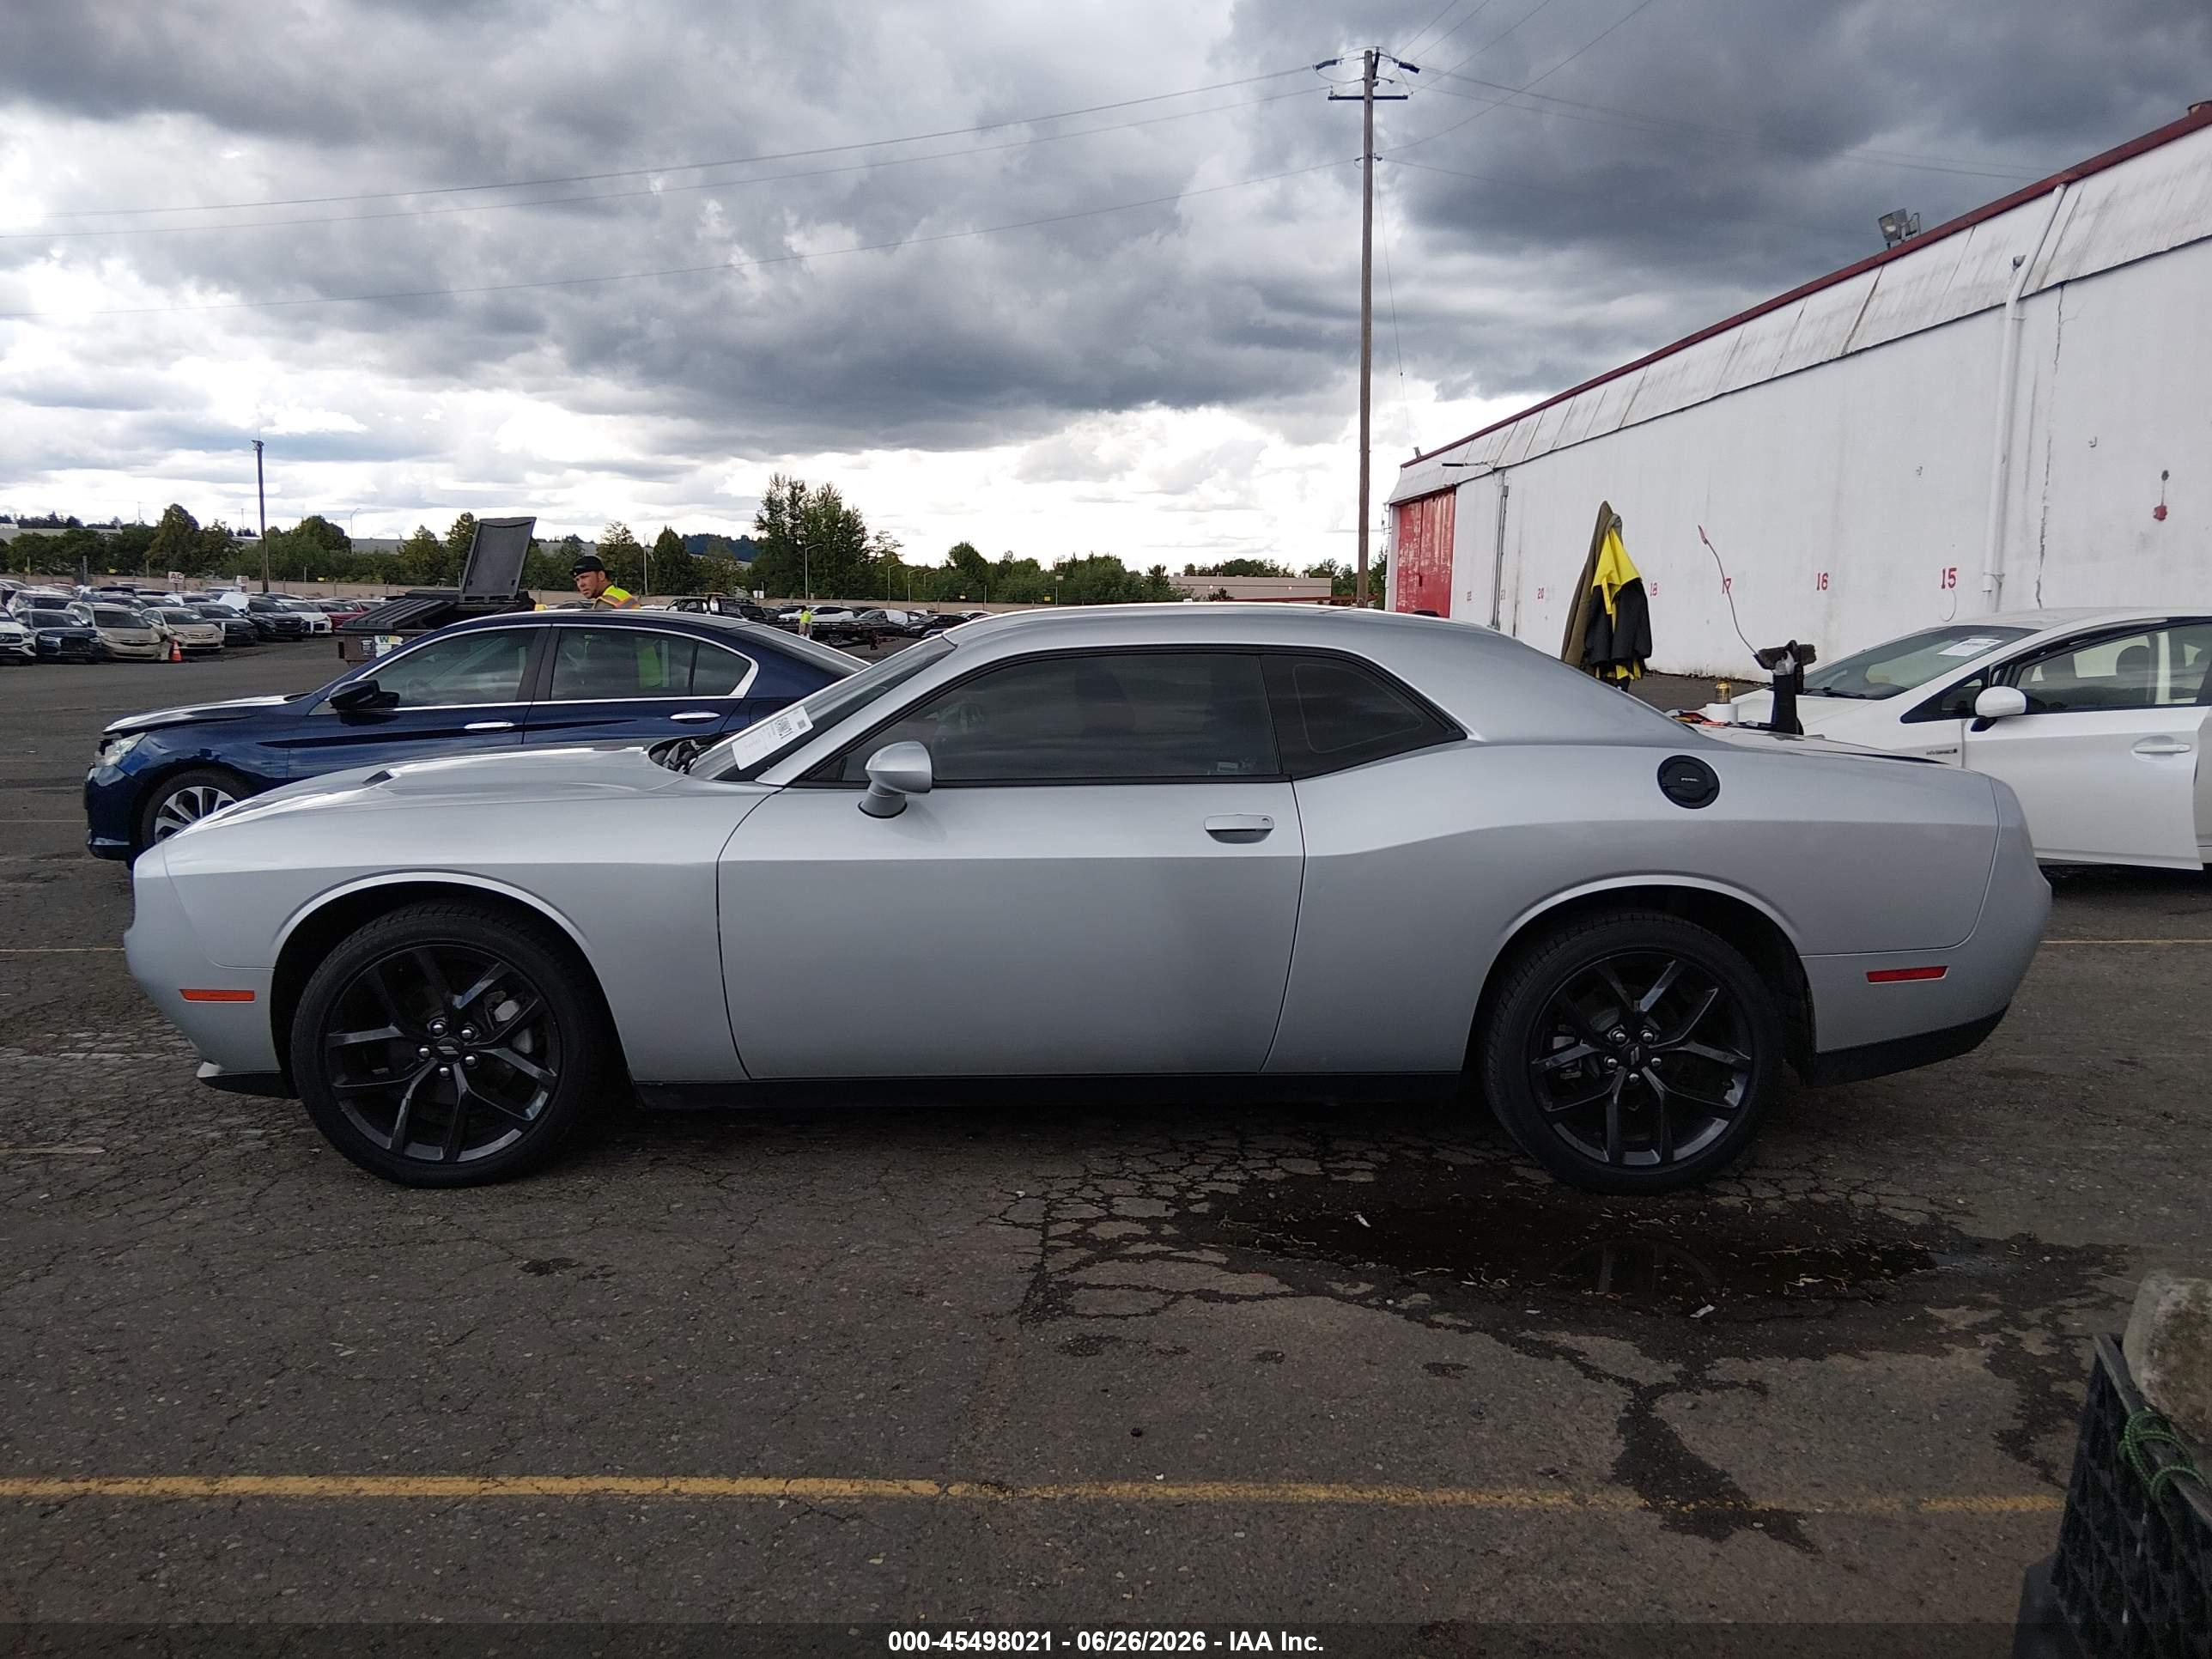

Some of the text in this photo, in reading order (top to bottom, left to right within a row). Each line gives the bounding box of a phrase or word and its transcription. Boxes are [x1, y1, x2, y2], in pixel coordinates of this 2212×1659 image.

[1816, 572, 1829, 591] 16
[1941, 567, 1957, 589] 15
[1537, 587, 1545, 599] 20
